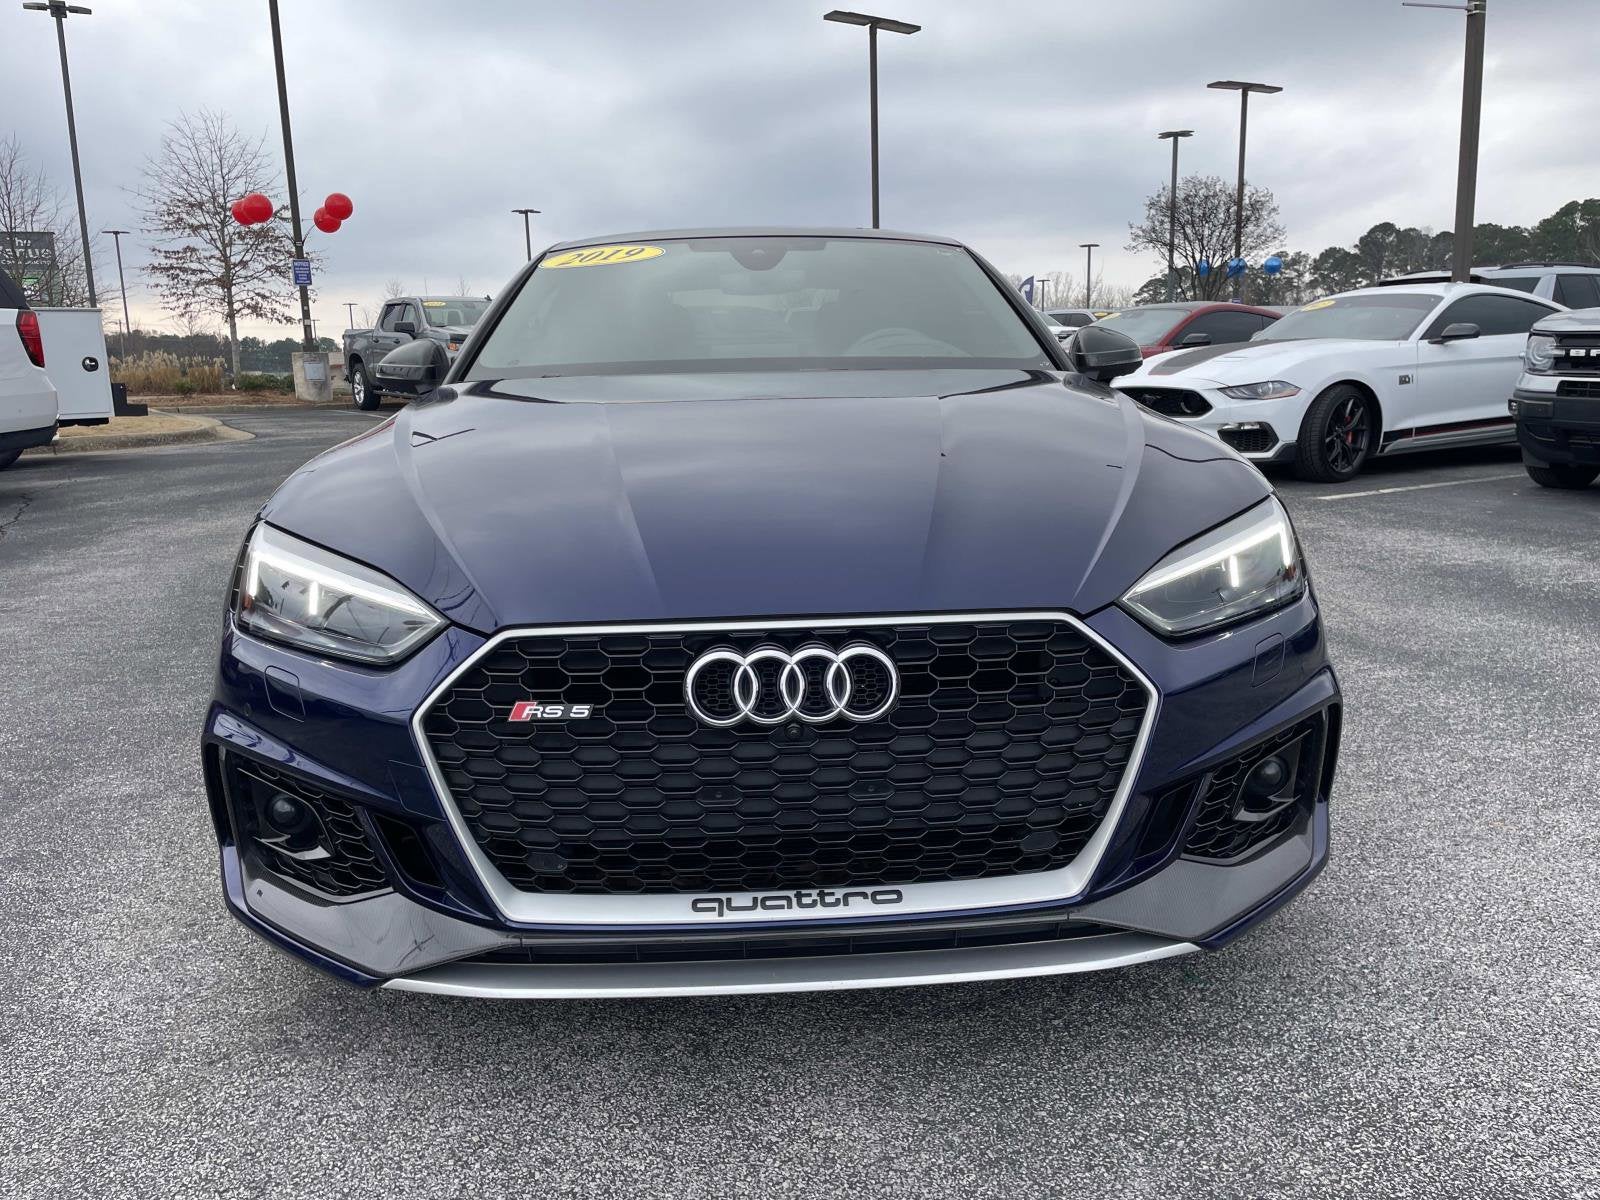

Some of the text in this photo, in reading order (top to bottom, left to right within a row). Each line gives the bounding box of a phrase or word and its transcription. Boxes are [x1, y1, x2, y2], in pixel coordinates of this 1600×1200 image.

[0, 246, 52, 258] enue
[554, 247, 645, 267] 2019
[691, 889, 904, 918] quattro
